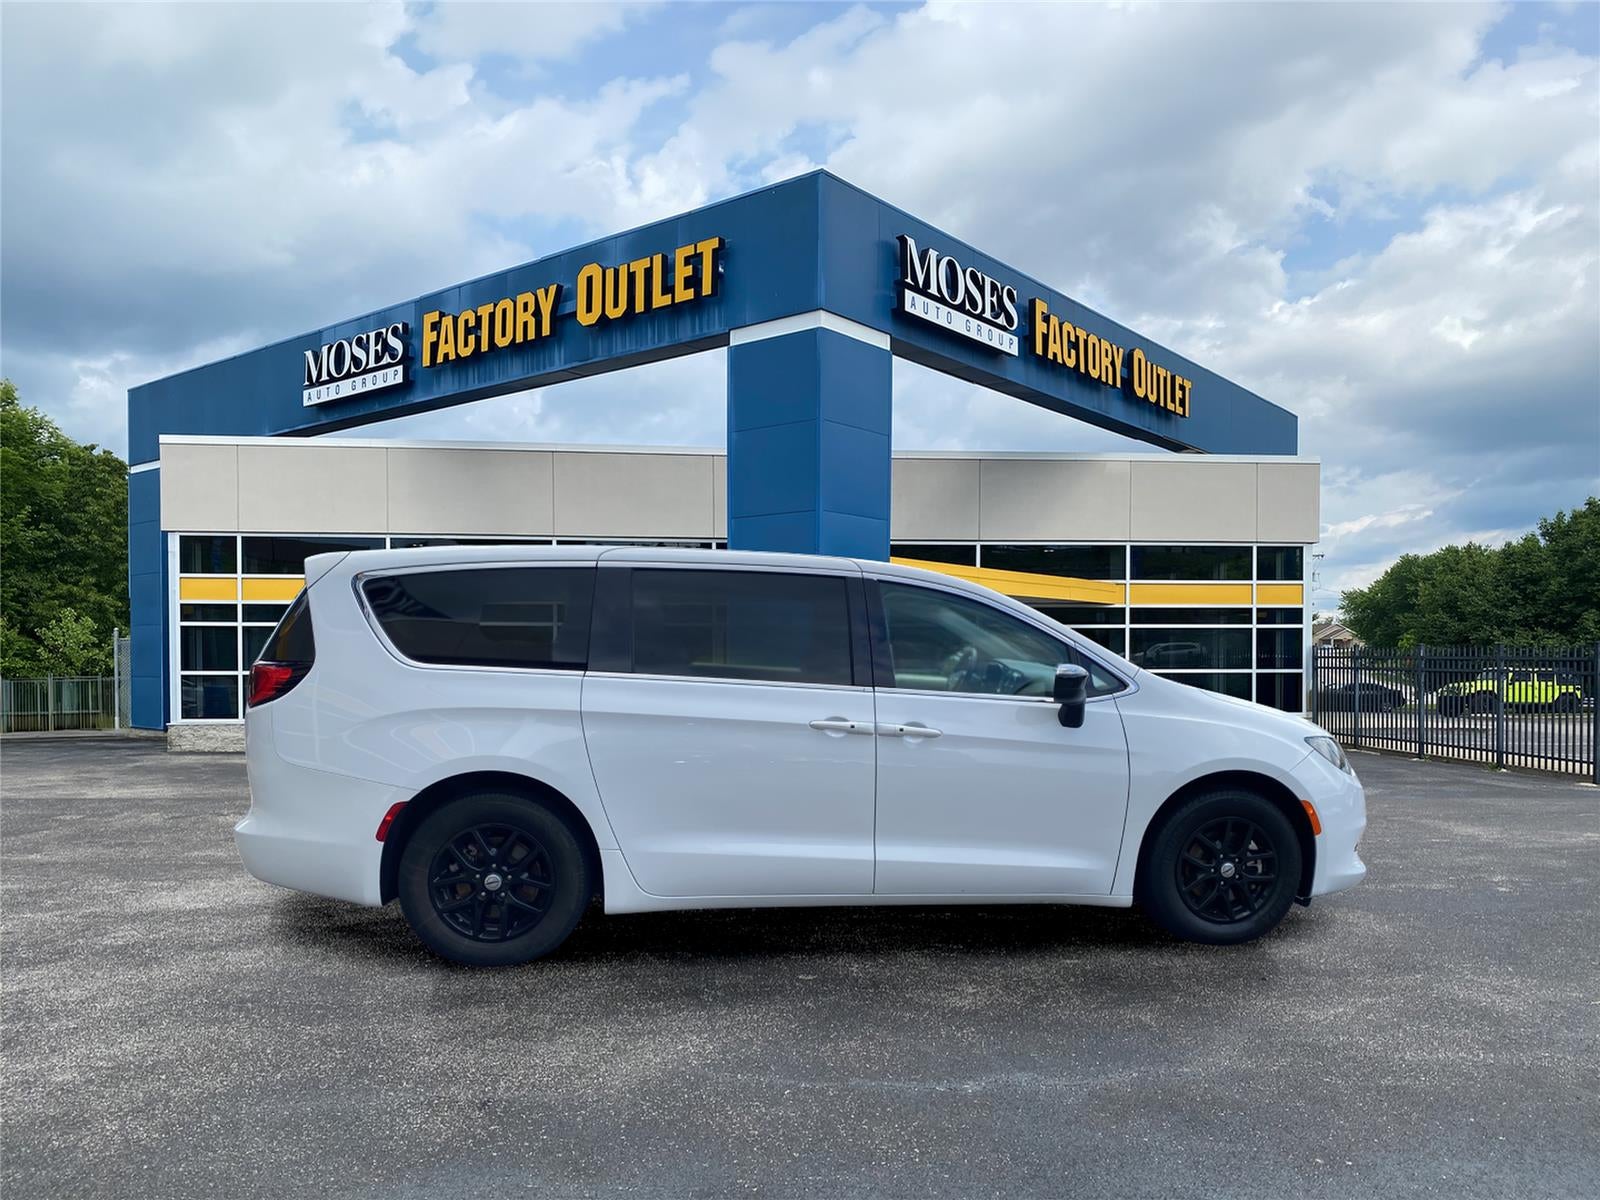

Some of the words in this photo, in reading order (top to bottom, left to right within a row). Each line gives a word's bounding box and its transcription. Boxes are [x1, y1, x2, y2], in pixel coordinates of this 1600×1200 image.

[422, 284, 558, 367] FACTORY
[576, 237, 720, 327] OUTLET
[904, 234, 1019, 331] MOSES
[909, 295, 953, 325] AUTO
[965, 318, 1015, 350] GROUP
[303, 322, 404, 386] MOSES
[306, 383, 341, 403] AUTO
[350, 370, 400, 392] GROUP
[1035, 297, 1124, 389] FACTORY
[1132, 348, 1192, 418] OUTLET
